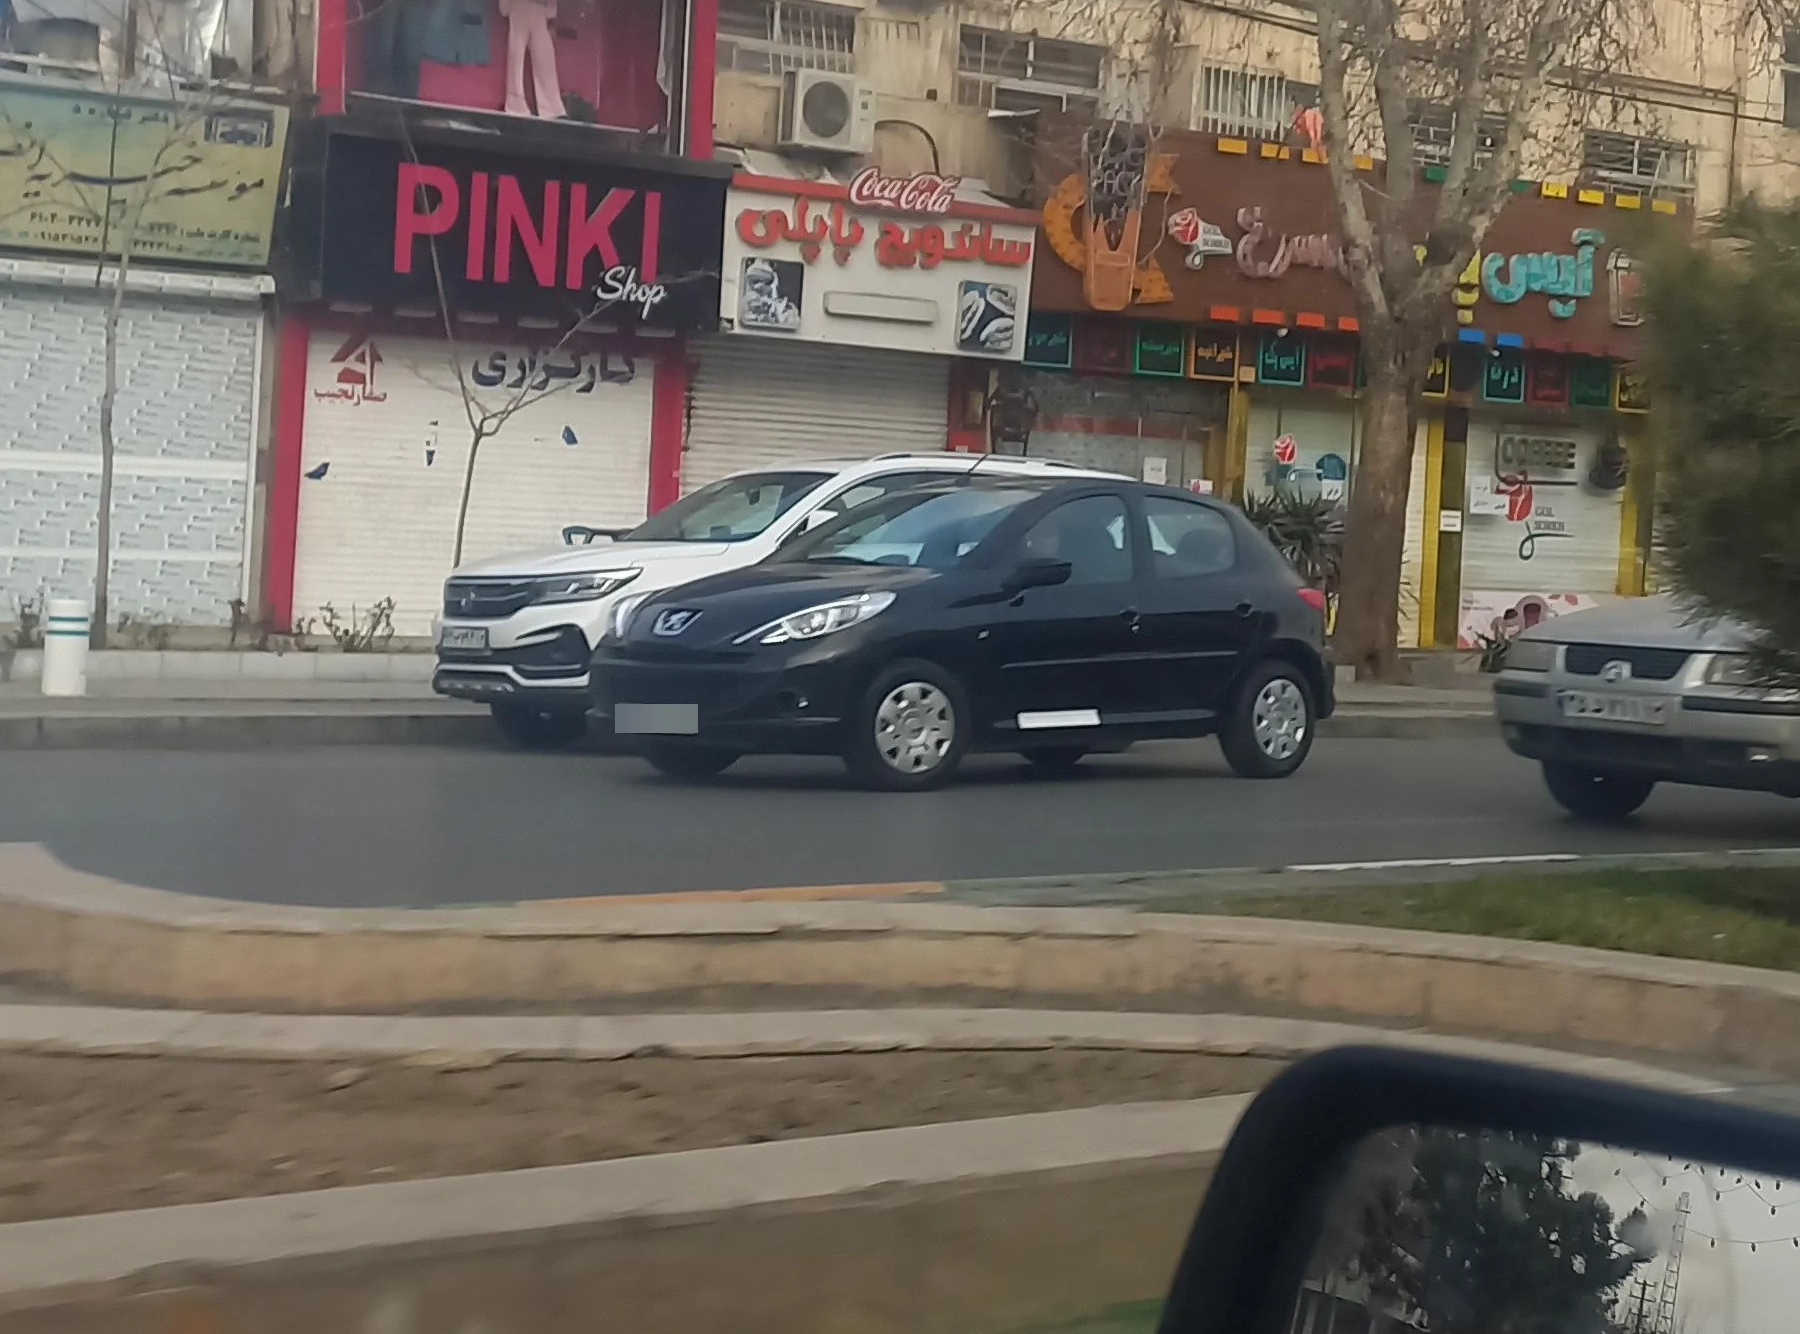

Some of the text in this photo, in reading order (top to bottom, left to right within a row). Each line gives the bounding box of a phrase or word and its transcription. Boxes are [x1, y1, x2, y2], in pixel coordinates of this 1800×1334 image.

[394, 162, 662, 291] PINKI
[594, 266, 667, 320] Shop
[1482, 228, 1606, 319] آیس
